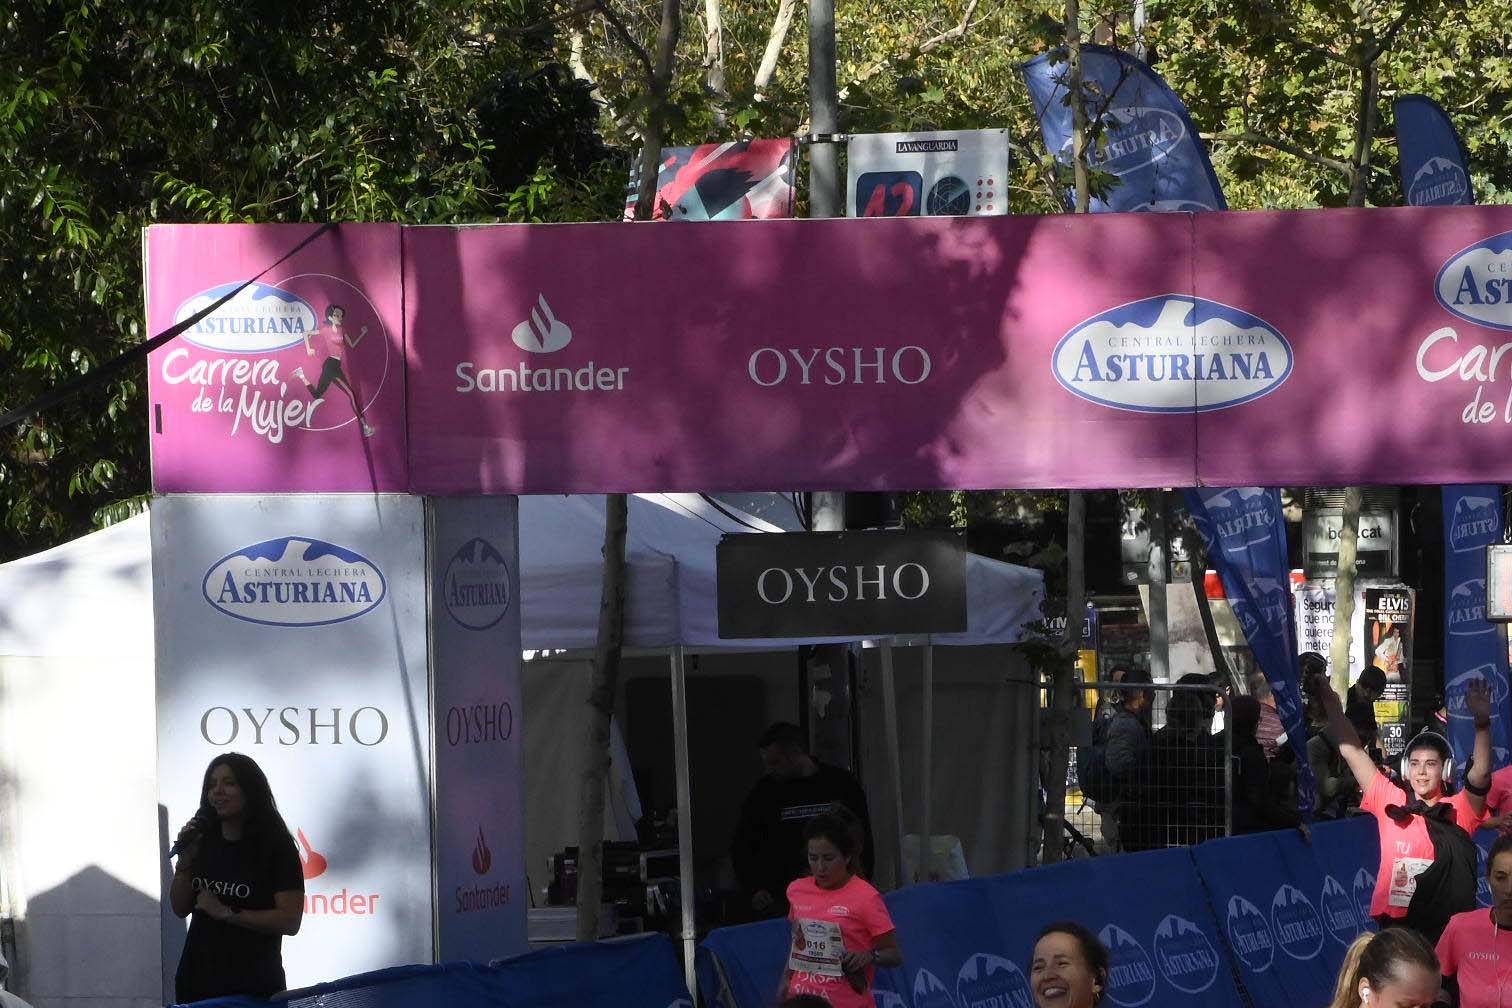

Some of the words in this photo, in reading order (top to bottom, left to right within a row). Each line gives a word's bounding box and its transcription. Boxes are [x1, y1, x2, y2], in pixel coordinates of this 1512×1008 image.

[1108, 336, 1182, 348] CENTRAL
[162, 348, 280, 385] Carrera
[455, 361, 629, 392] Santander
[748, 345, 931, 386] OYSHO
[1071, 339, 1274, 382] ASTURIANA
[192, 387, 213, 412] de
[218, 387, 233, 412] la
[231, 383, 325, 443] Mujer
[1462, 386, 1496, 423] de
[217, 570, 373, 604] ASTURIANA
[245, 568, 303, 577] CENTRAL
[308, 568, 367, 577] LECHERA
[757, 562, 930, 604] OYSHO
[1379, 597, 1409, 610] ELVIS
[200, 706, 389, 746] OYSHO
[446, 701, 512, 746] OYSHO
[1390, 727, 1402, 737] 30
[192, 875, 250, 899] OYSHO
[455, 881, 511, 914] Santander
